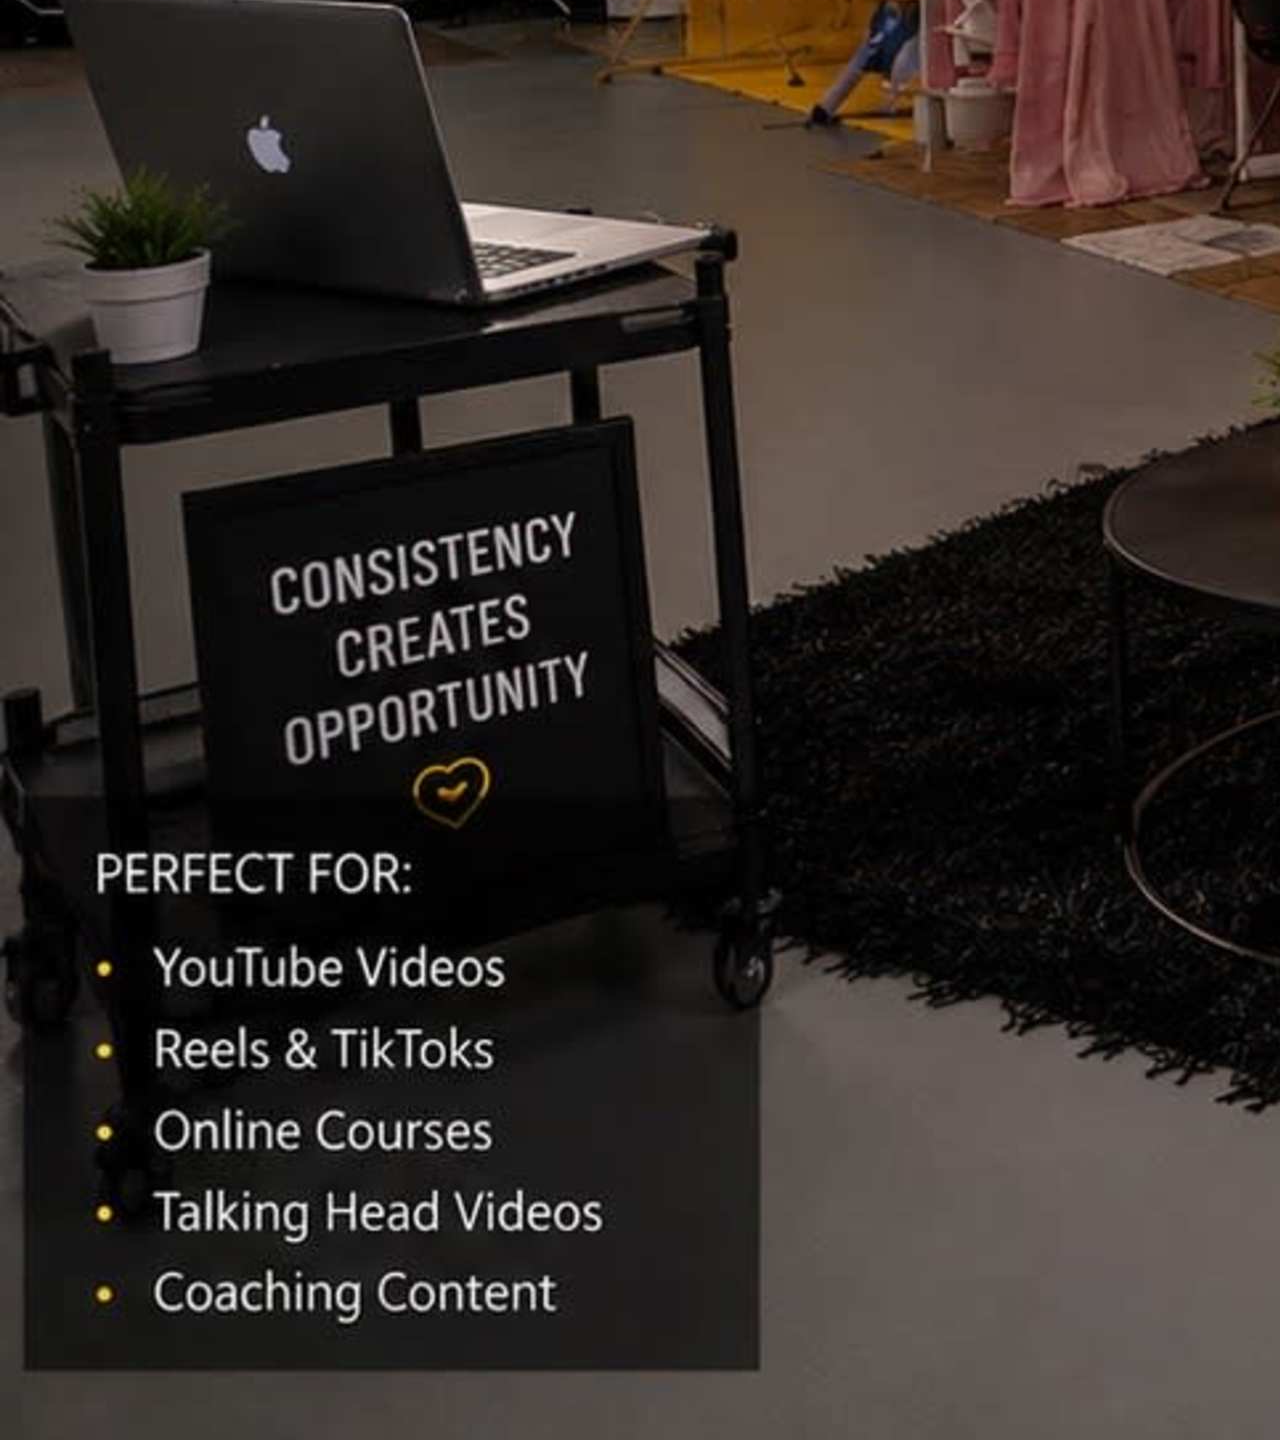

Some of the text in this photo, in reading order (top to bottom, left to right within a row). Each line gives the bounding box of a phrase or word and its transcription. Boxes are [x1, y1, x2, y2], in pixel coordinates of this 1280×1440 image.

[270, 511, 578, 615] CONSISTENCY
[335, 593, 532, 678] CREATES
[284, 651, 590, 766] OPPORTUNITY
